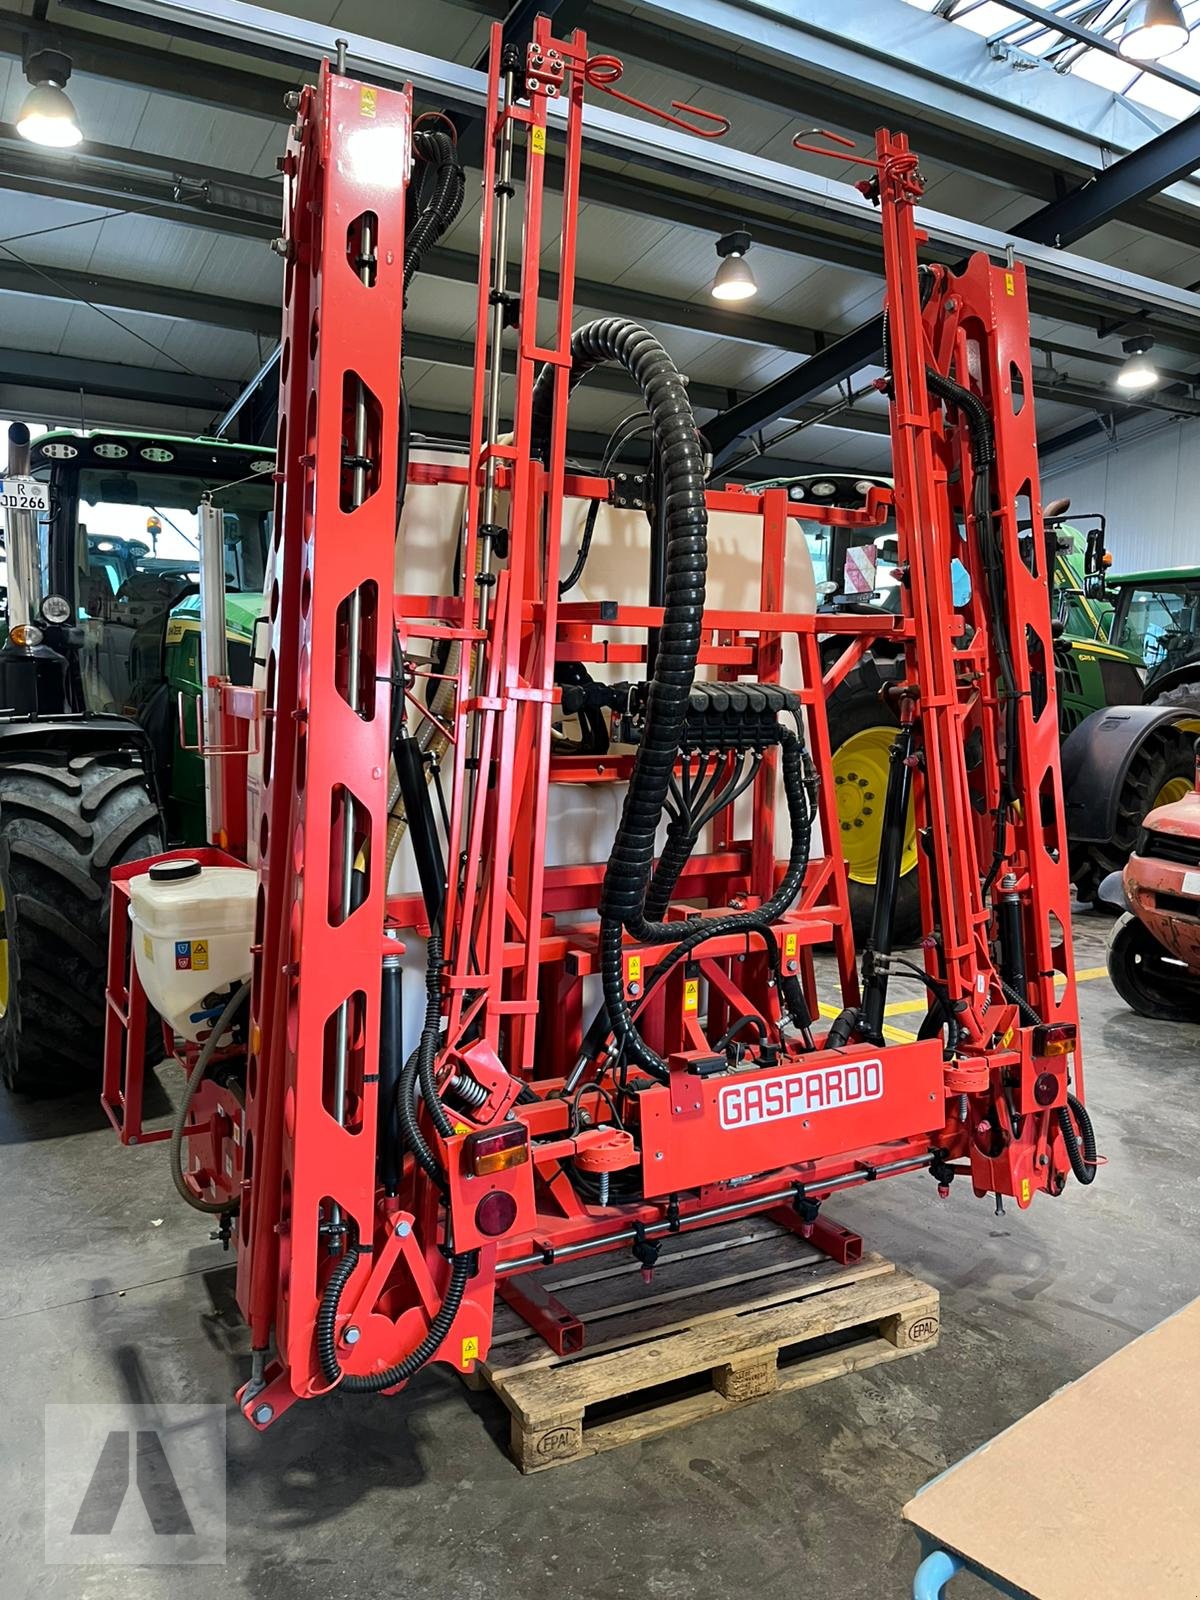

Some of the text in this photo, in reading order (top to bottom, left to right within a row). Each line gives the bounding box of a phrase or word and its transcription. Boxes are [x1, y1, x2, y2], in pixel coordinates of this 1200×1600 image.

[17, 484, 26, 495] R
[0, 494, 45, 509] JD 266
[722, 1063, 880, 1125] GASPARDO
[913, 1321, 935, 1339] EPAL
